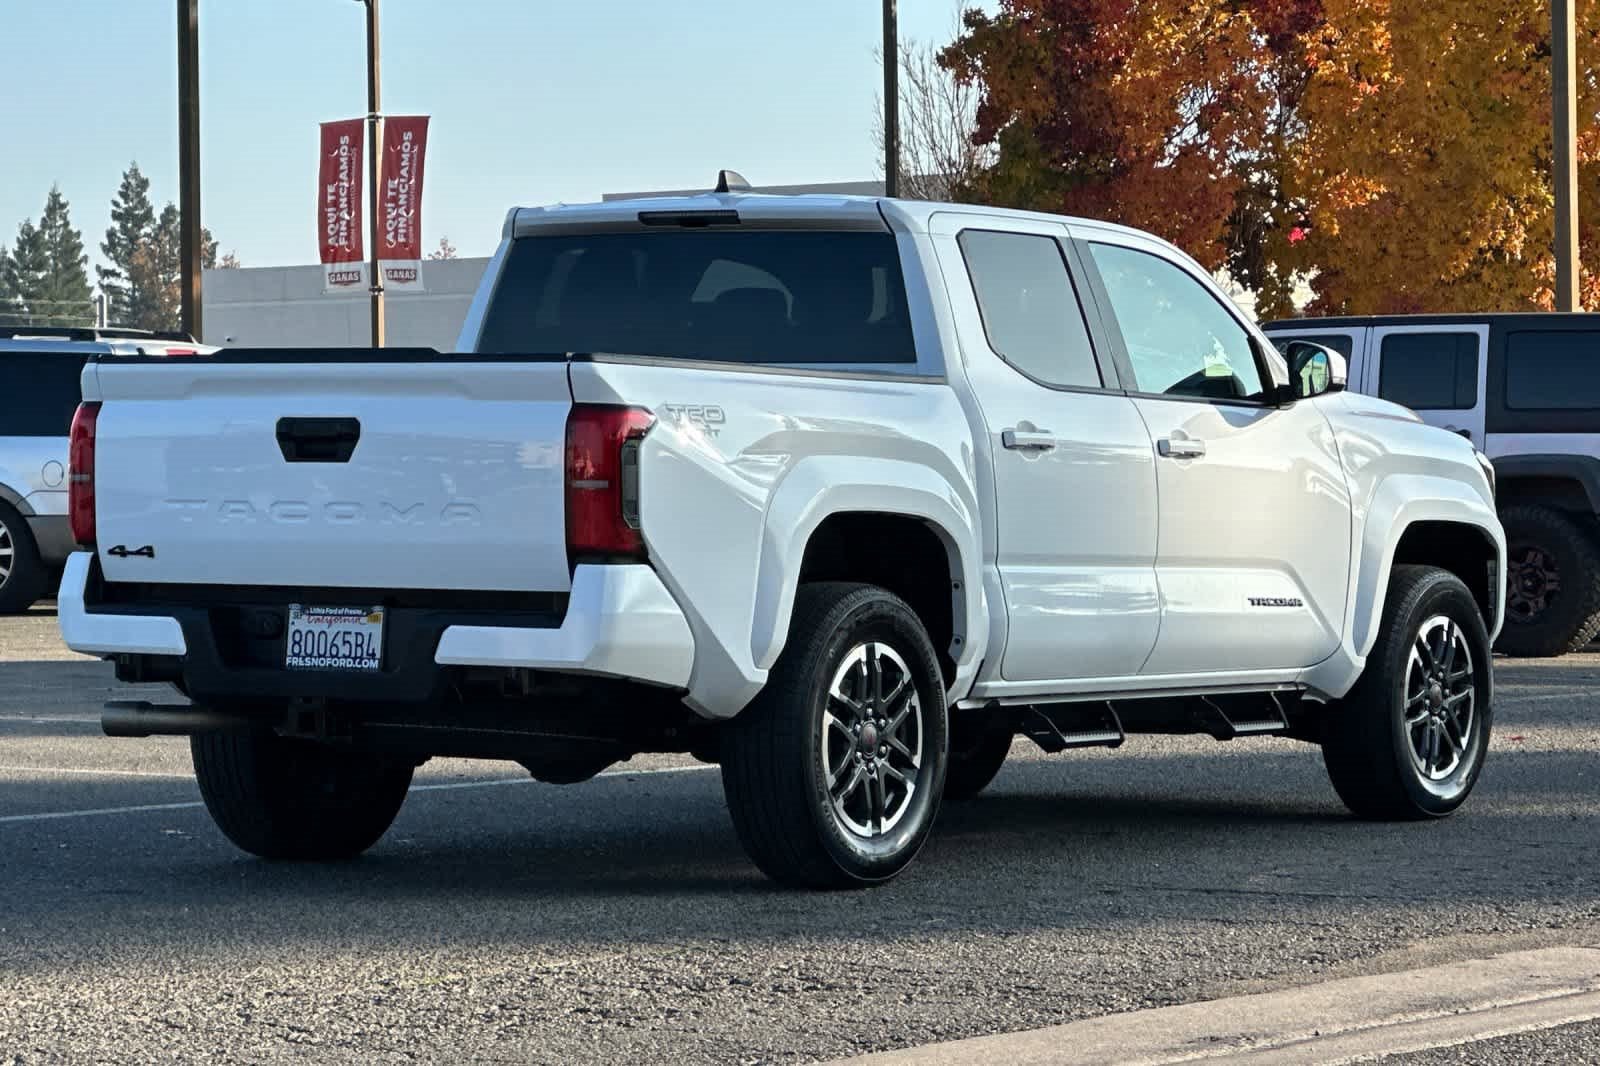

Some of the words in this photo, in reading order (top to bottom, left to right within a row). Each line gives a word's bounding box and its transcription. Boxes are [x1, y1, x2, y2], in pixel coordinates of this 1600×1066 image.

[327, 183, 337, 205] TE
[338, 135, 350, 246] FINANCIAMOS
[387, 178, 399, 198] TE
[397, 131, 413, 243] FINANCIAMOS
[329, 271, 360, 283] GANAS
[386, 270, 416, 280] GANAS
[163, 500, 482, 526] TACOMA
[291, 629, 376, 659] 80065B4
